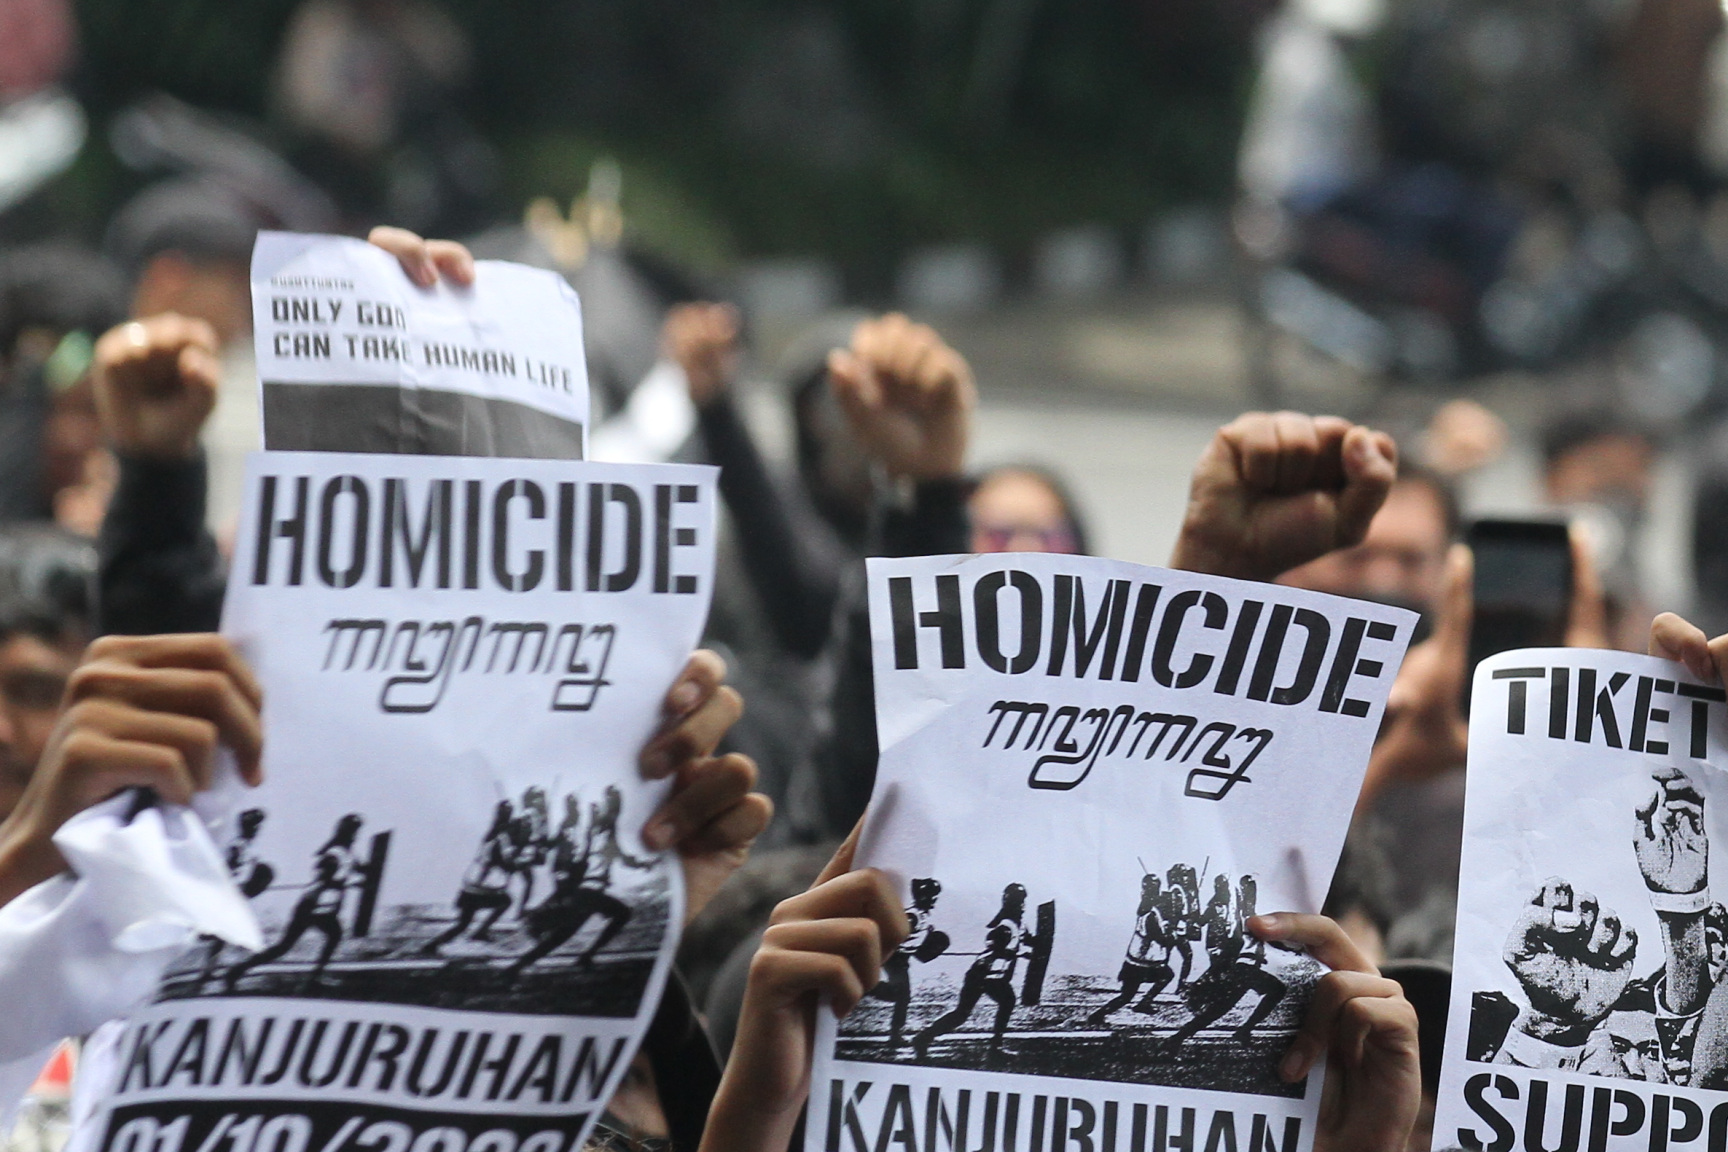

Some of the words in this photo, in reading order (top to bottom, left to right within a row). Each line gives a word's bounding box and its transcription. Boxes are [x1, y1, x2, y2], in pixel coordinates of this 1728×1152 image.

[271, 297, 342, 323] ONLY
[273, 332, 332, 359] CAN
[423, 342, 516, 377] HUMAN
[525, 354, 573, 394] LIFE
[252, 475, 699, 593] HOMICIDE
[888, 569, 1398, 718] HOMICIDE
[1491, 667, 1728, 760] TIKET
[118, 1014, 630, 1103] KANJURUHAN
